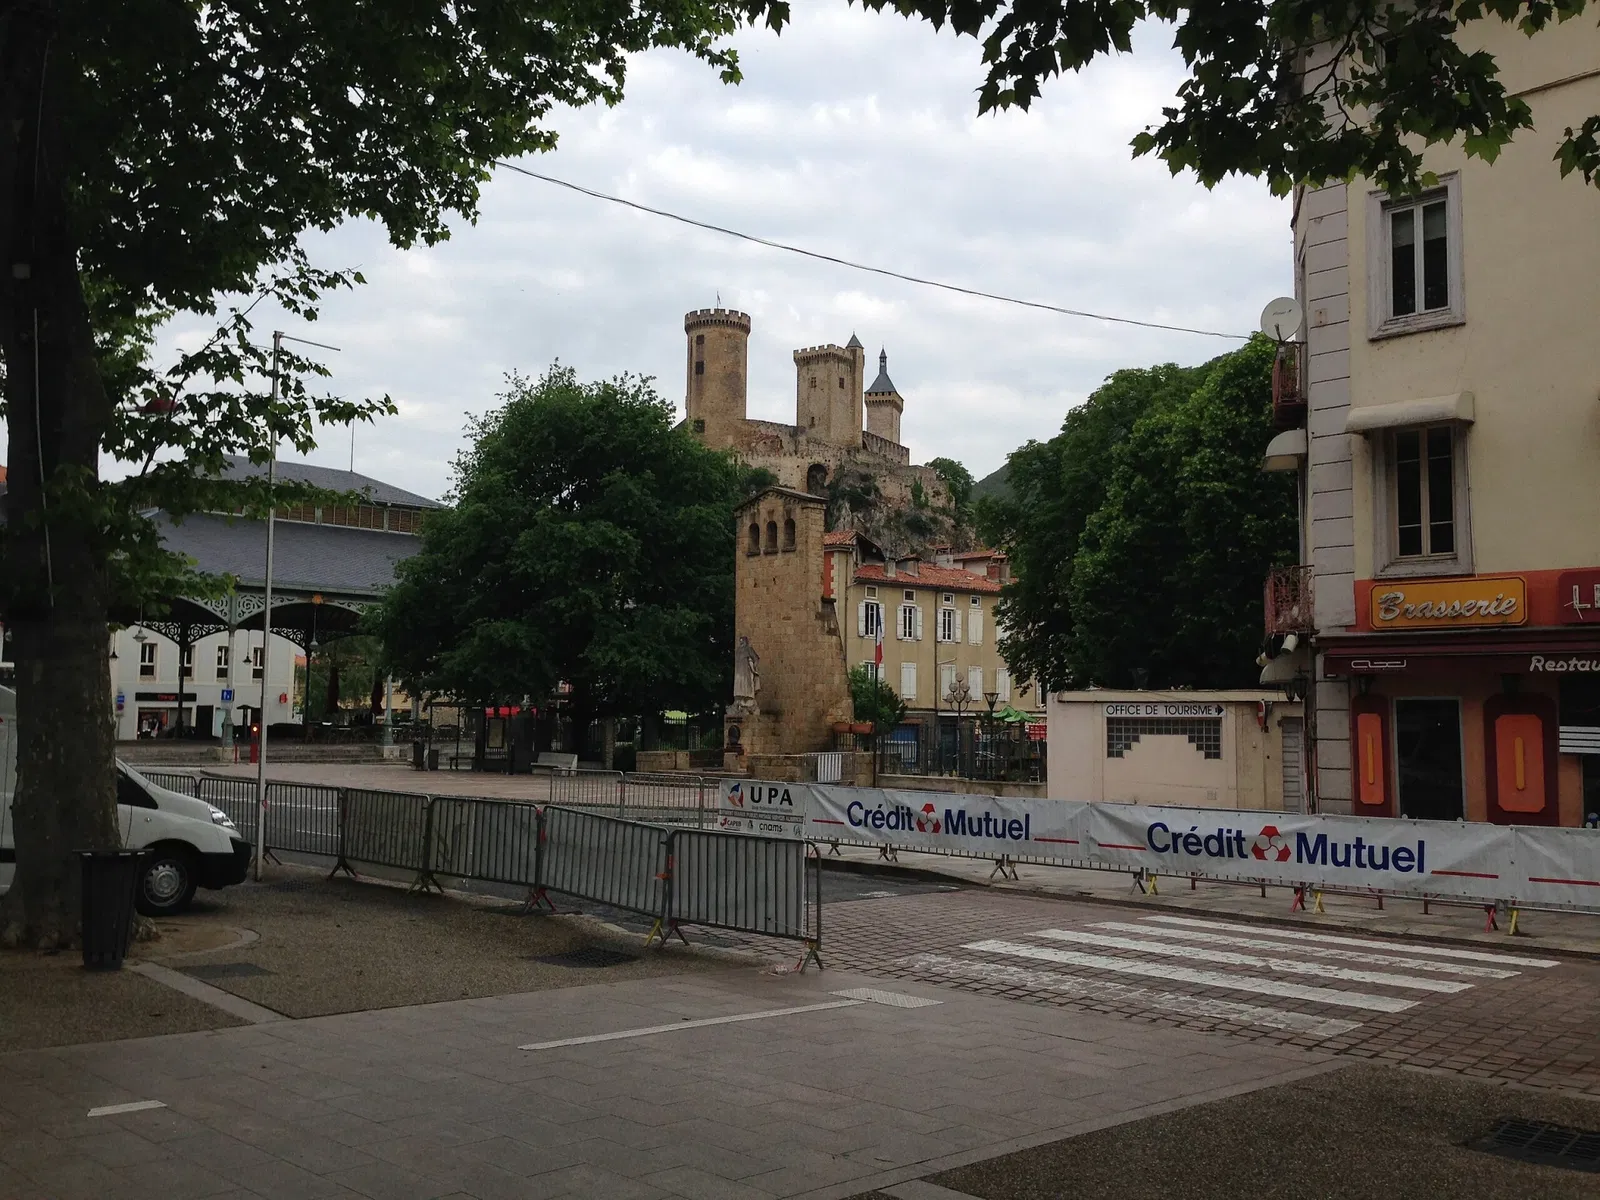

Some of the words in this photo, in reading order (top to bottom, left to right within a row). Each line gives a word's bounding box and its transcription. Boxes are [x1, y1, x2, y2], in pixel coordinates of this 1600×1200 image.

[1378, 591, 1518, 621] Brasserie
[1105, 704, 1141, 716] OFFICE
[1145, 704, 1159, 715] DE
[1163, 704, 1213, 716] TOURISME
[750, 786, 793, 805] UPA
[759, 822, 782, 832] cnams
[846, 801, 915, 832] Crédit
[943, 809, 1031, 841] Mutuel
[1146, 822, 1249, 860] Crédit
[1296, 832, 1426, 874] Mutuel
